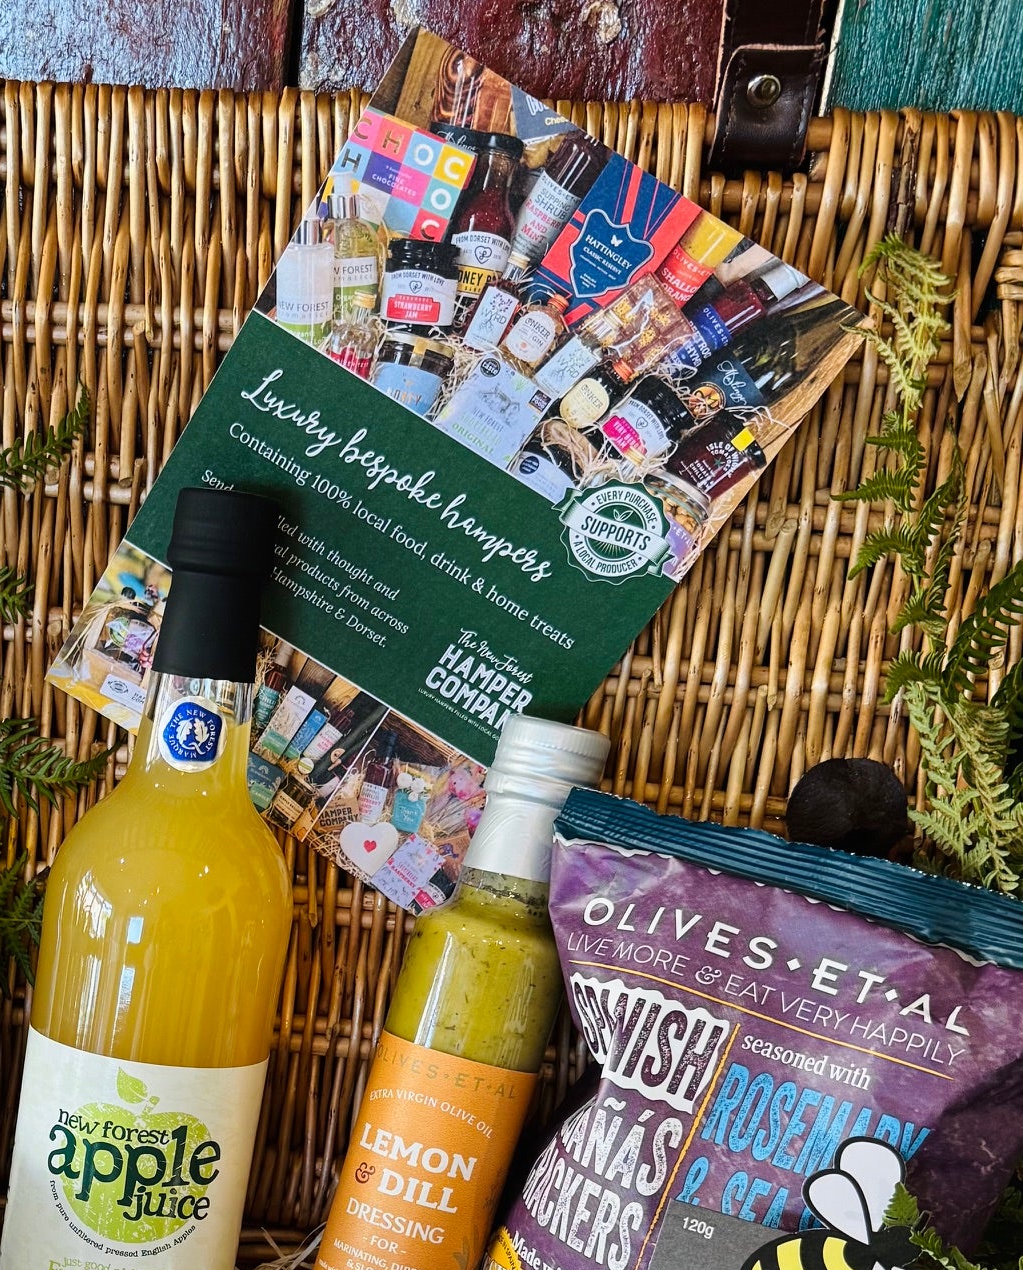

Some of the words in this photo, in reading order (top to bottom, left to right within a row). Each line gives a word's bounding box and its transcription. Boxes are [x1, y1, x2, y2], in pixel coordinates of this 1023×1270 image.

[520, 224, 546, 243] MINT
[585, 234, 632, 270] HATTINGLEY
[583, 247, 603, 264] CLASSIC
[404, 310, 418, 319] JAM
[241, 369, 342, 457] Luxury
[339, 428, 442, 509] bespoke
[440, 494, 552, 582] hampers
[596, 491, 624, 505] EVERY
[229, 423, 312, 486] Containing
[311, 475, 353, 509] 100%
[353, 500, 391, 533] local
[391, 525, 427, 561] food,
[430, 552, 471, 585] drink
[485, 585, 529, 621] home
[530, 615, 575, 650] treats
[581, 515, 650, 551] SUPPORTS
[285, 554, 340, 591] products
[326, 550, 374, 585] thought
[373, 581, 400, 600] and
[575, 545, 597, 568] LOCAL
[458, 628, 477, 649] The
[477, 641, 499, 663] New
[438, 644, 533, 713] HAMPER
[206, 719, 216, 751] FOREST
[566, 931, 618, 957] LIVE
[612, 942, 691, 977] MORE
[779, 995, 852, 1032] VERY
[849, 1018, 966, 1067] HAPPILY
[741, 1032, 826, 1078] seasoned
[369, 1088, 394, 1101] EXTRA
[440, 1099, 476, 1125] OLIVE
[58, 1108, 98, 1135] new
[102, 1120, 170, 1146] forest
[47, 1124, 221, 1207] apple
[359, 1122, 478, 1182] LEMON
[122, 1185, 211, 1221] juice
[377, 1168, 459, 1215] DILL
[345, 1197, 446, 1245] DRESSING
[682, 1216, 715, 1239] 120g
[62, 1257, 82, 1268] just
[333, 1238, 389, 1269] MARINATING,
[512, 1230, 540, 1270] Made
